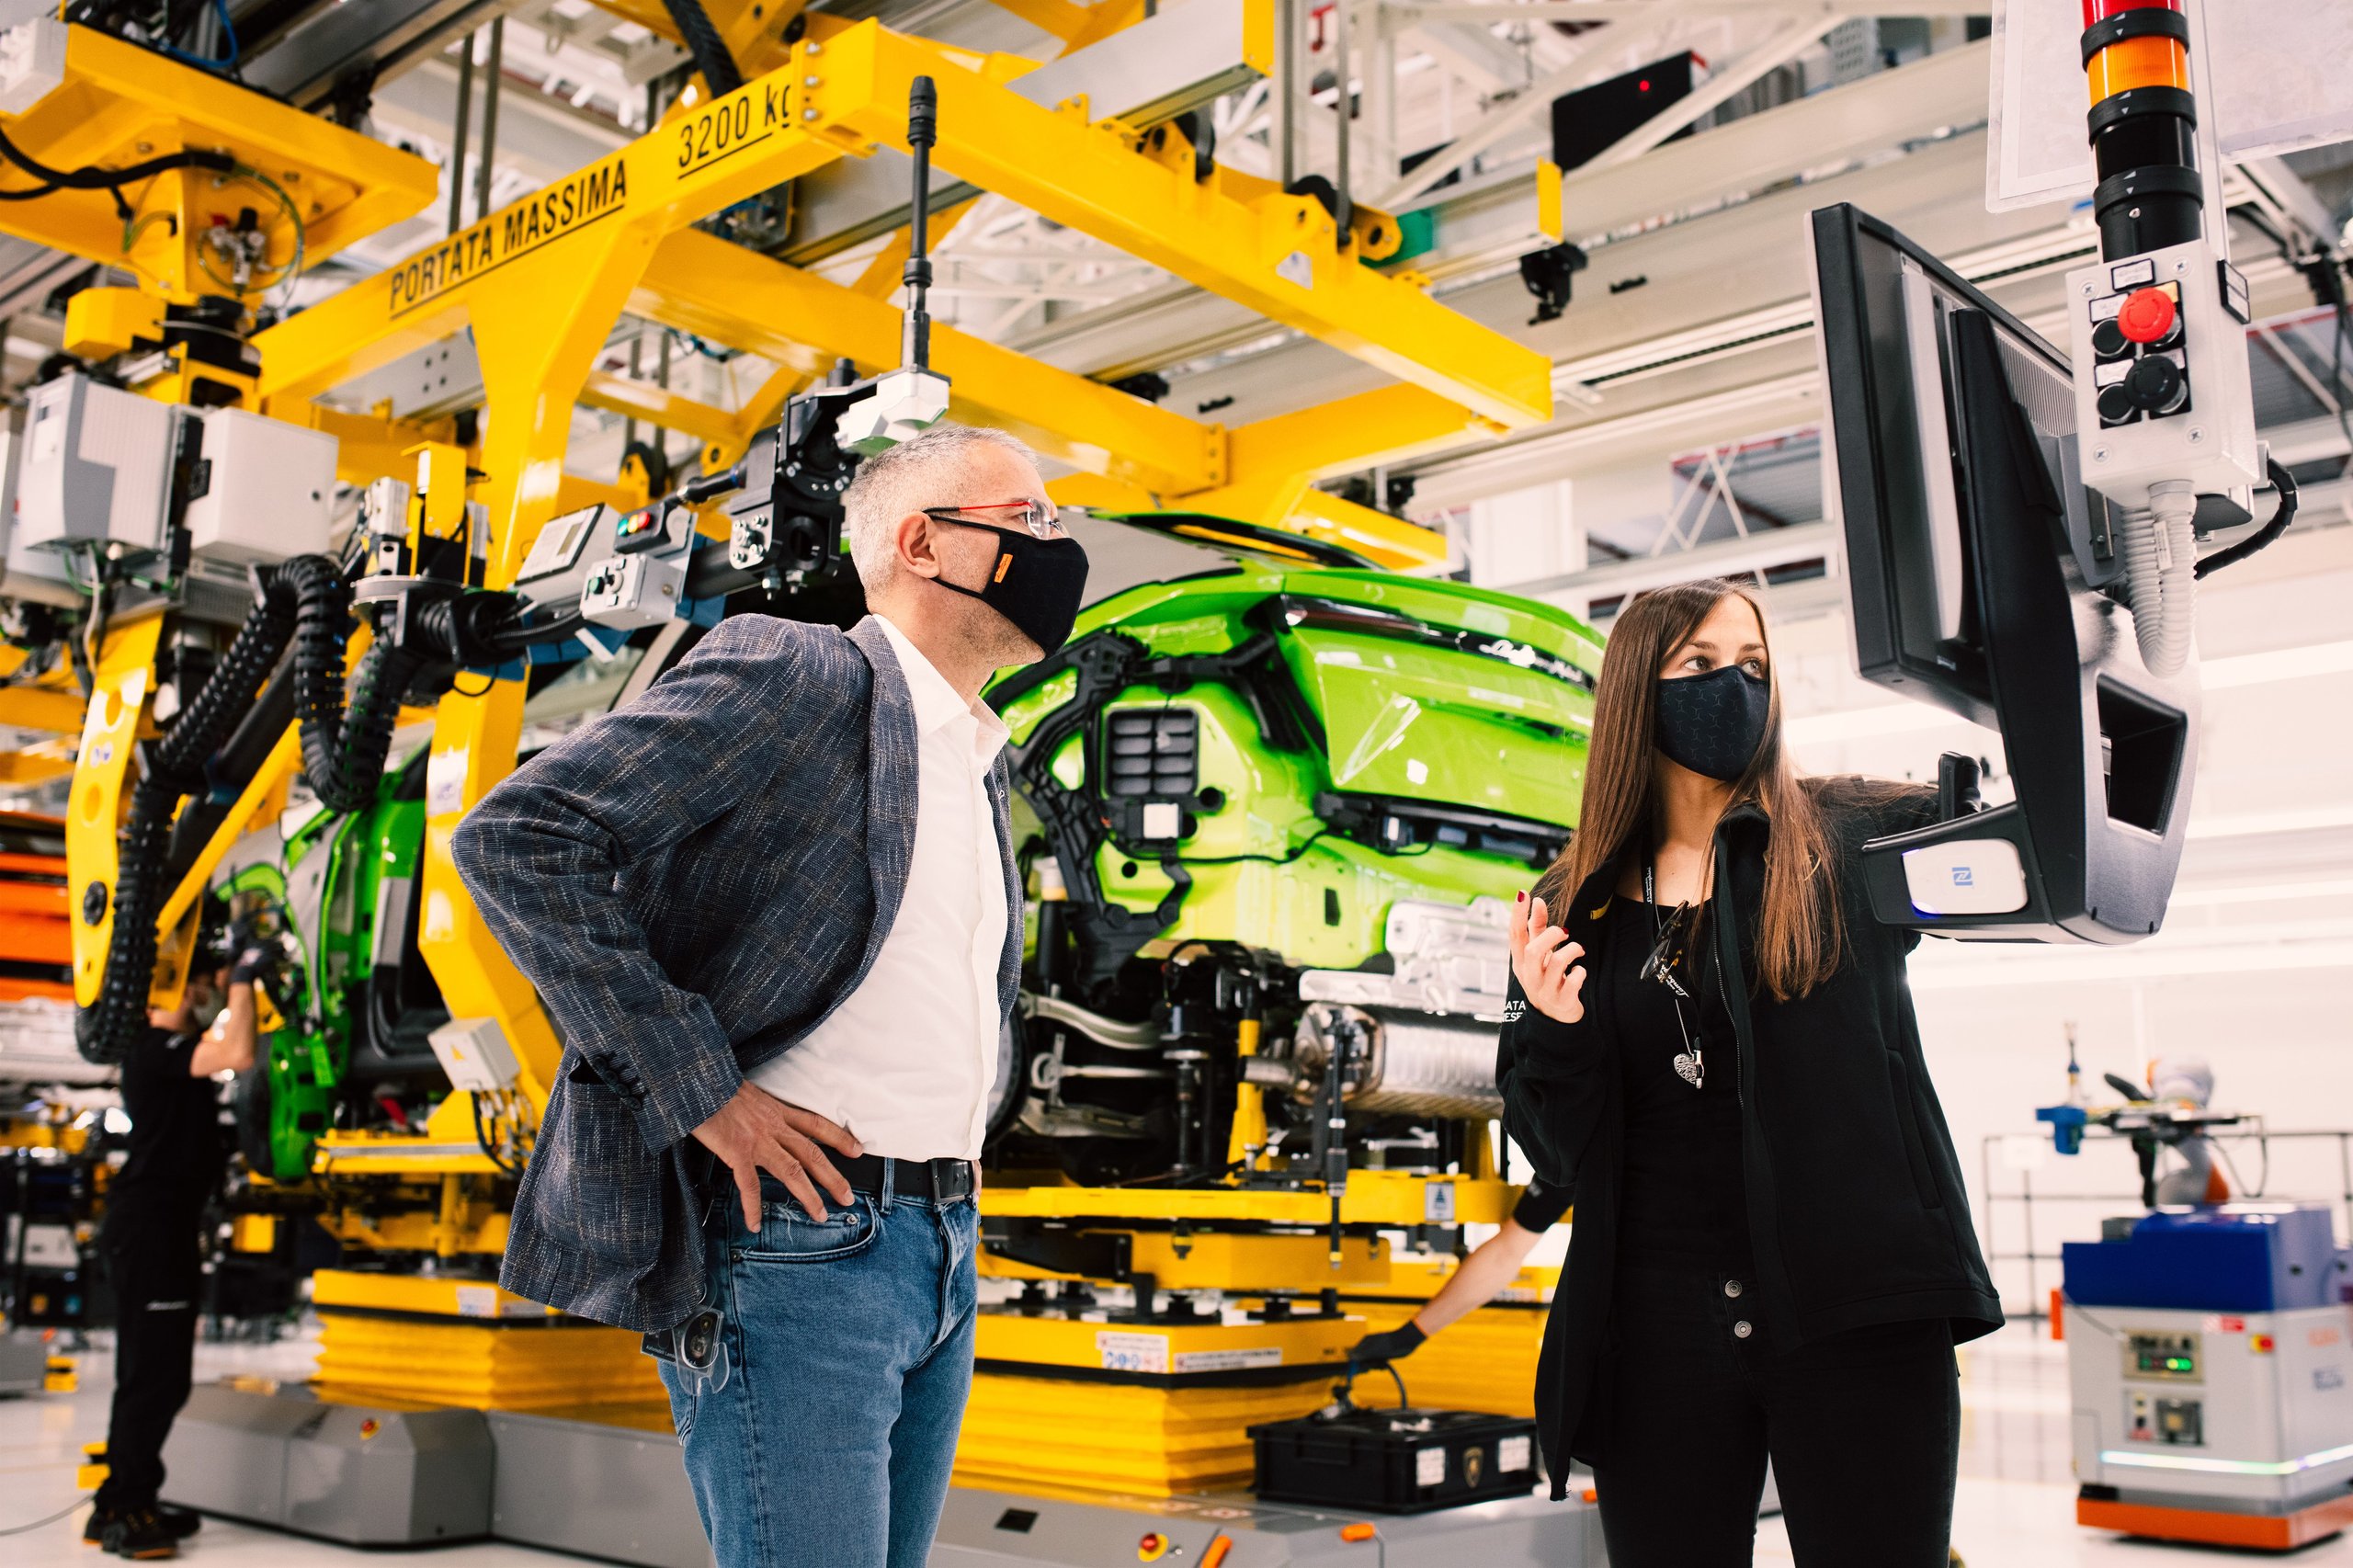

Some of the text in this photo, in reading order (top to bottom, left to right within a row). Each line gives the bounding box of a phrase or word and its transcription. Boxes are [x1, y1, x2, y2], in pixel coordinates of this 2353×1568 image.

[390, 224, 493, 310] PORTATA
[504, 159, 627, 255] MASSIMA
[678, 97, 749, 168] 3200
[1505, 1000, 1526, 1011] ATA
